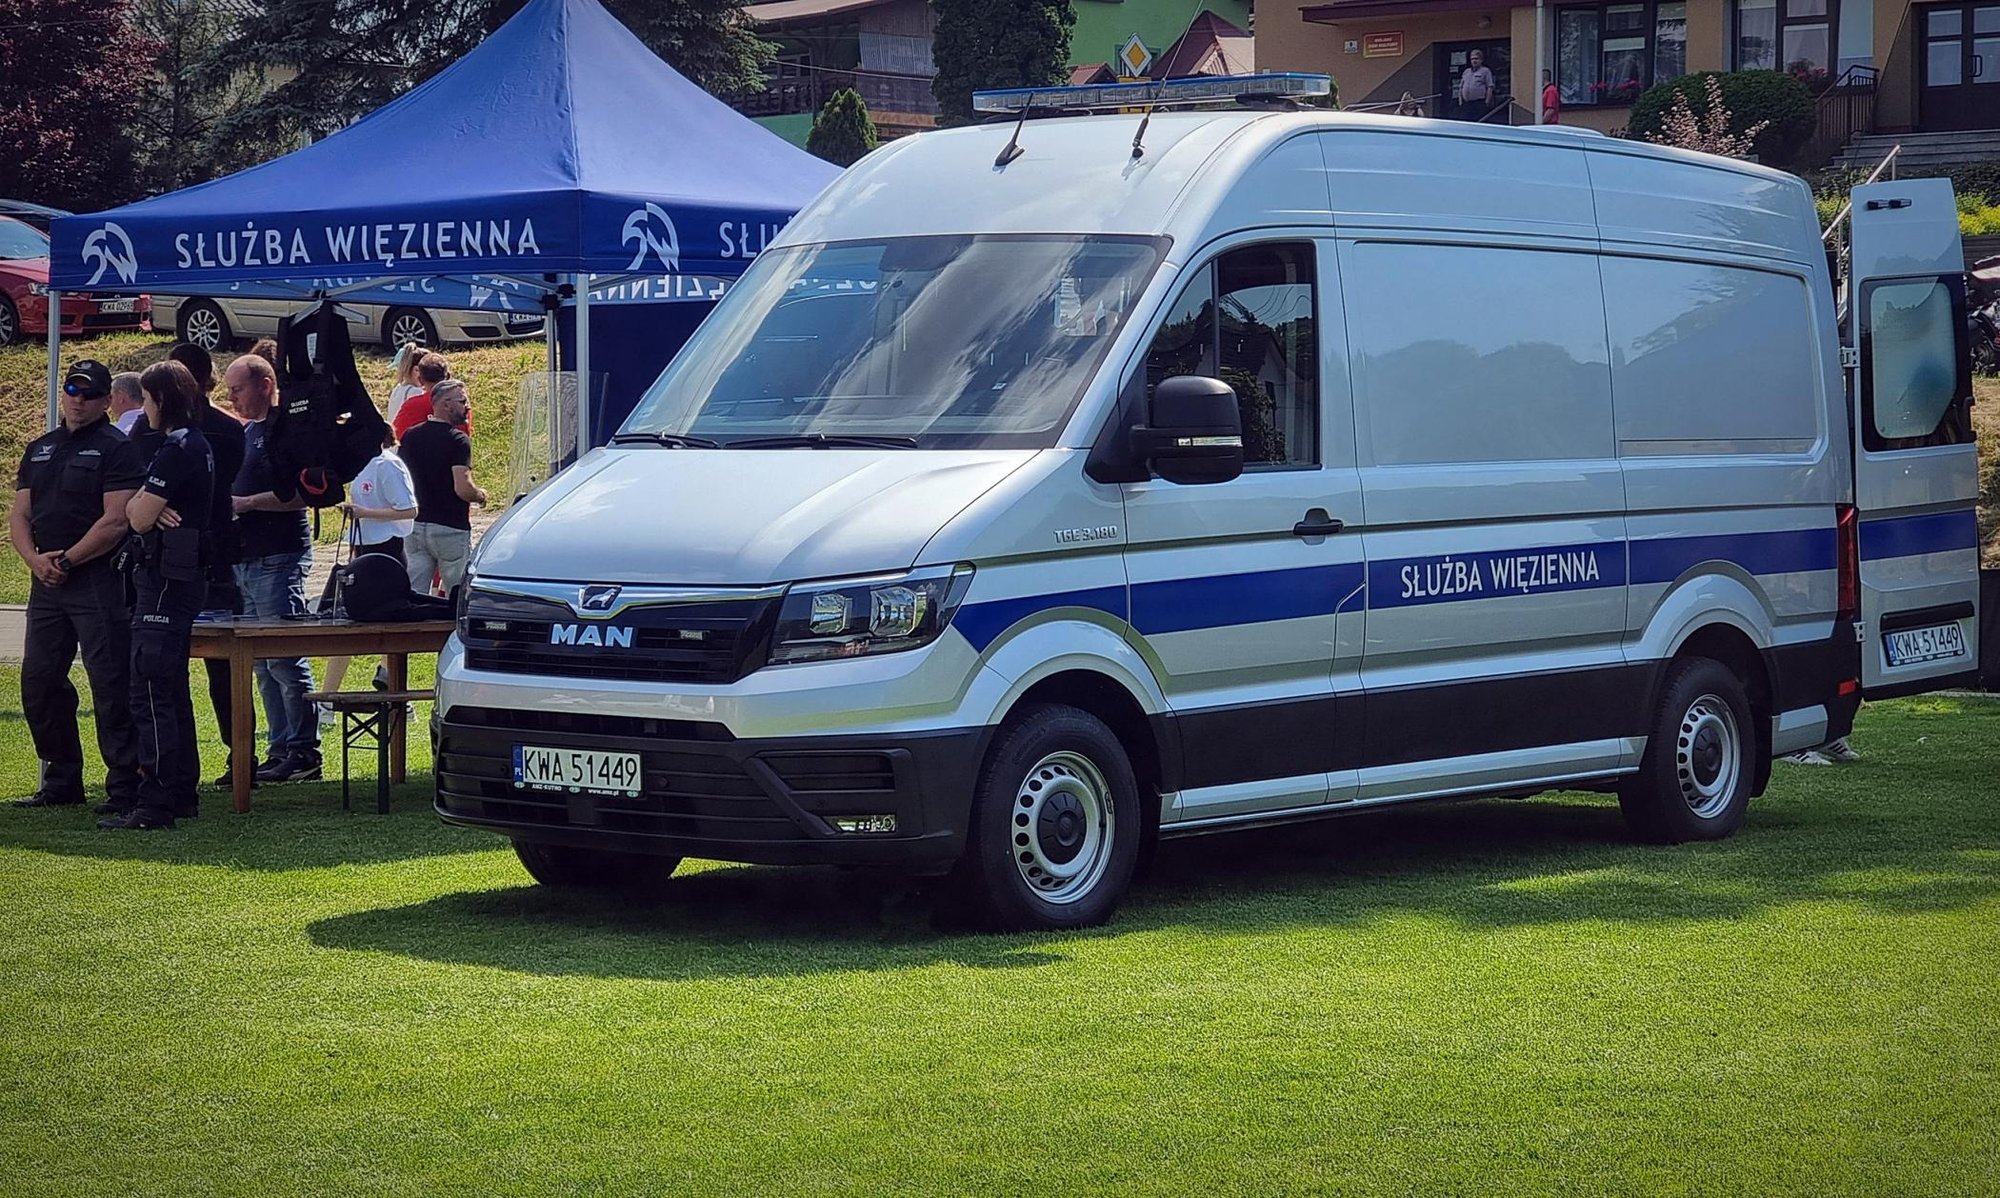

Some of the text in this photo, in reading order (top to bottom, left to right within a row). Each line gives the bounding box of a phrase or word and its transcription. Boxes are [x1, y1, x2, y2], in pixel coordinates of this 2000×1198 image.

[175, 218, 540, 268] SŁUŻBA WIĘZIENNA
[719, 216, 792, 258] SŁU
[1053, 528, 1080, 543] TGE
[1401, 550, 1600, 598] SŁUŻBA WIĘZIENNA
[143, 614, 170, 624] POLICJA
[550, 623, 633, 648] MAN
[1893, 626, 1959, 658] KWA 51449
[514, 767, 523, 776] PL
[524, 749, 638, 787] KWA 51449
